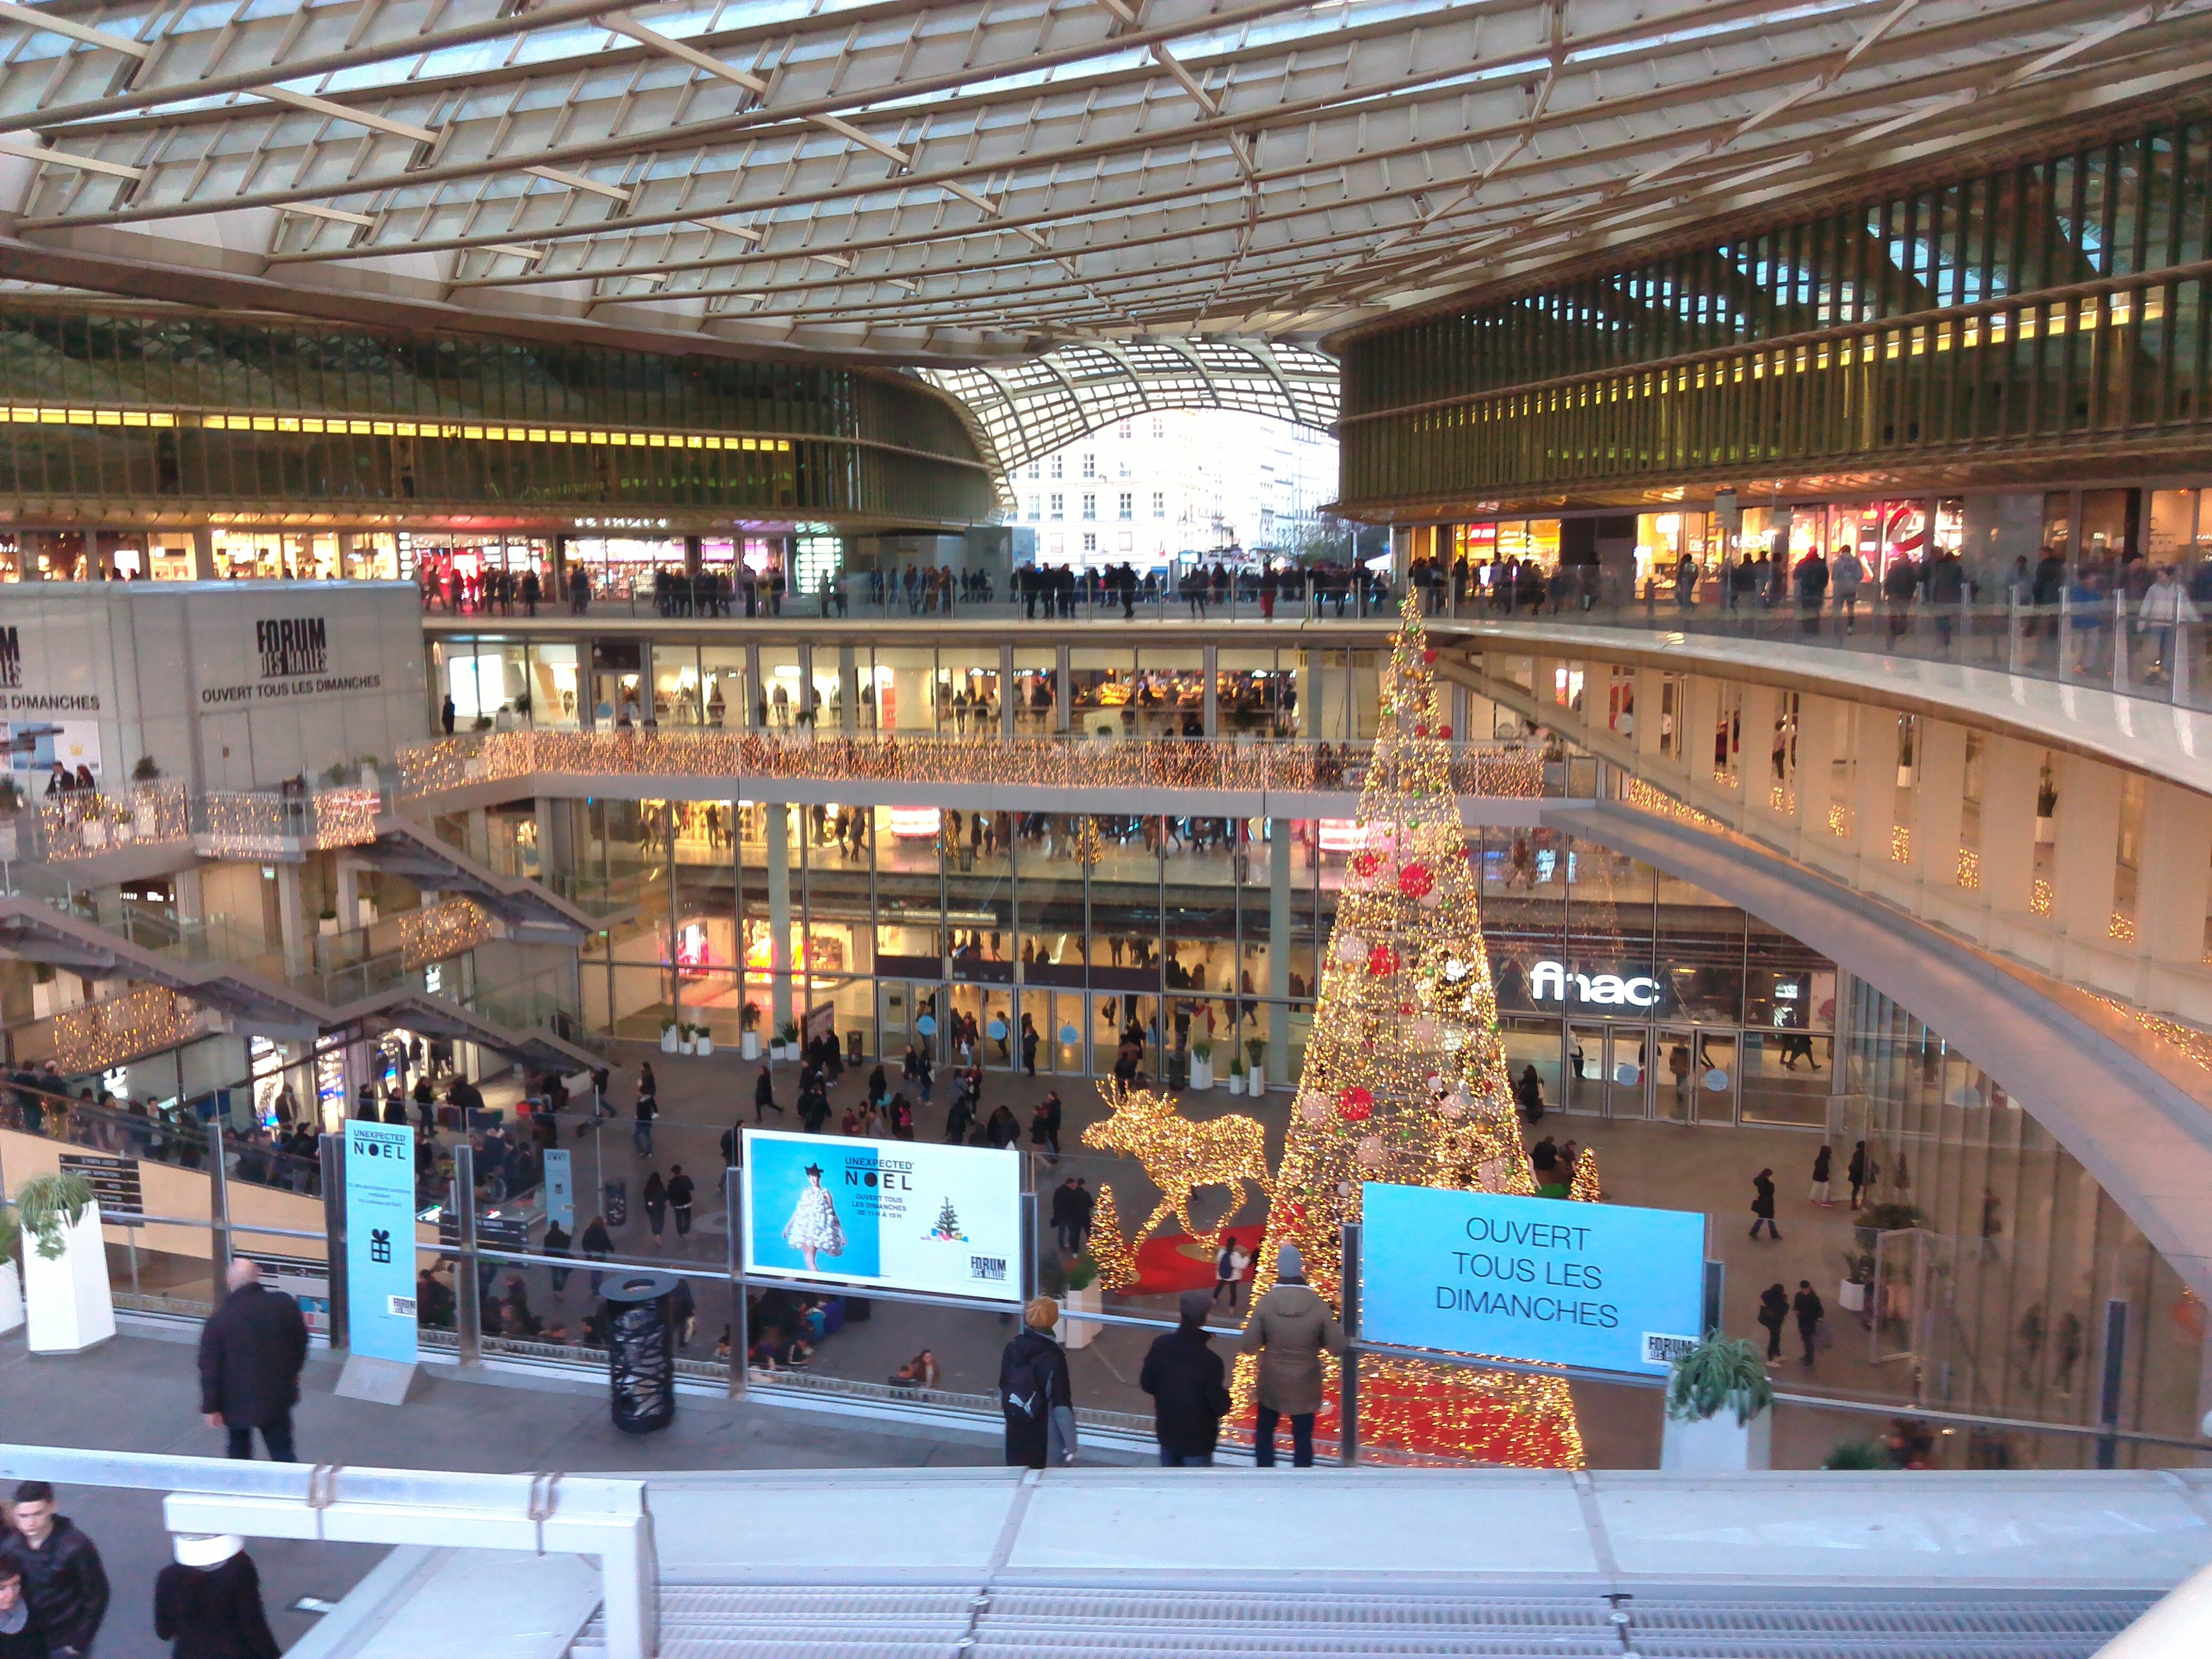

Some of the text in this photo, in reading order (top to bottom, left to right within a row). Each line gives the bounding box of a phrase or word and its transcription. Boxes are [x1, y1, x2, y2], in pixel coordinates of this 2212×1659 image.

[256, 617, 326, 653] FORUM
[11, 693, 100, 711] DIMANCHES
[202, 674, 381, 703] OUVERT TOUS LES DIMANCHES
[1530, 961, 1660, 1007] fnac
[855, 1193, 883, 1202] OUVERT
[866, 1202, 907, 1212] DIMANCHES
[1466, 1217, 1592, 1251] OUVERT
[970, 1255, 1007, 1272] FORUM
[1451, 1251, 1603, 1290] TOUS LES
[1437, 1286, 1619, 1328] DIMANCHES
